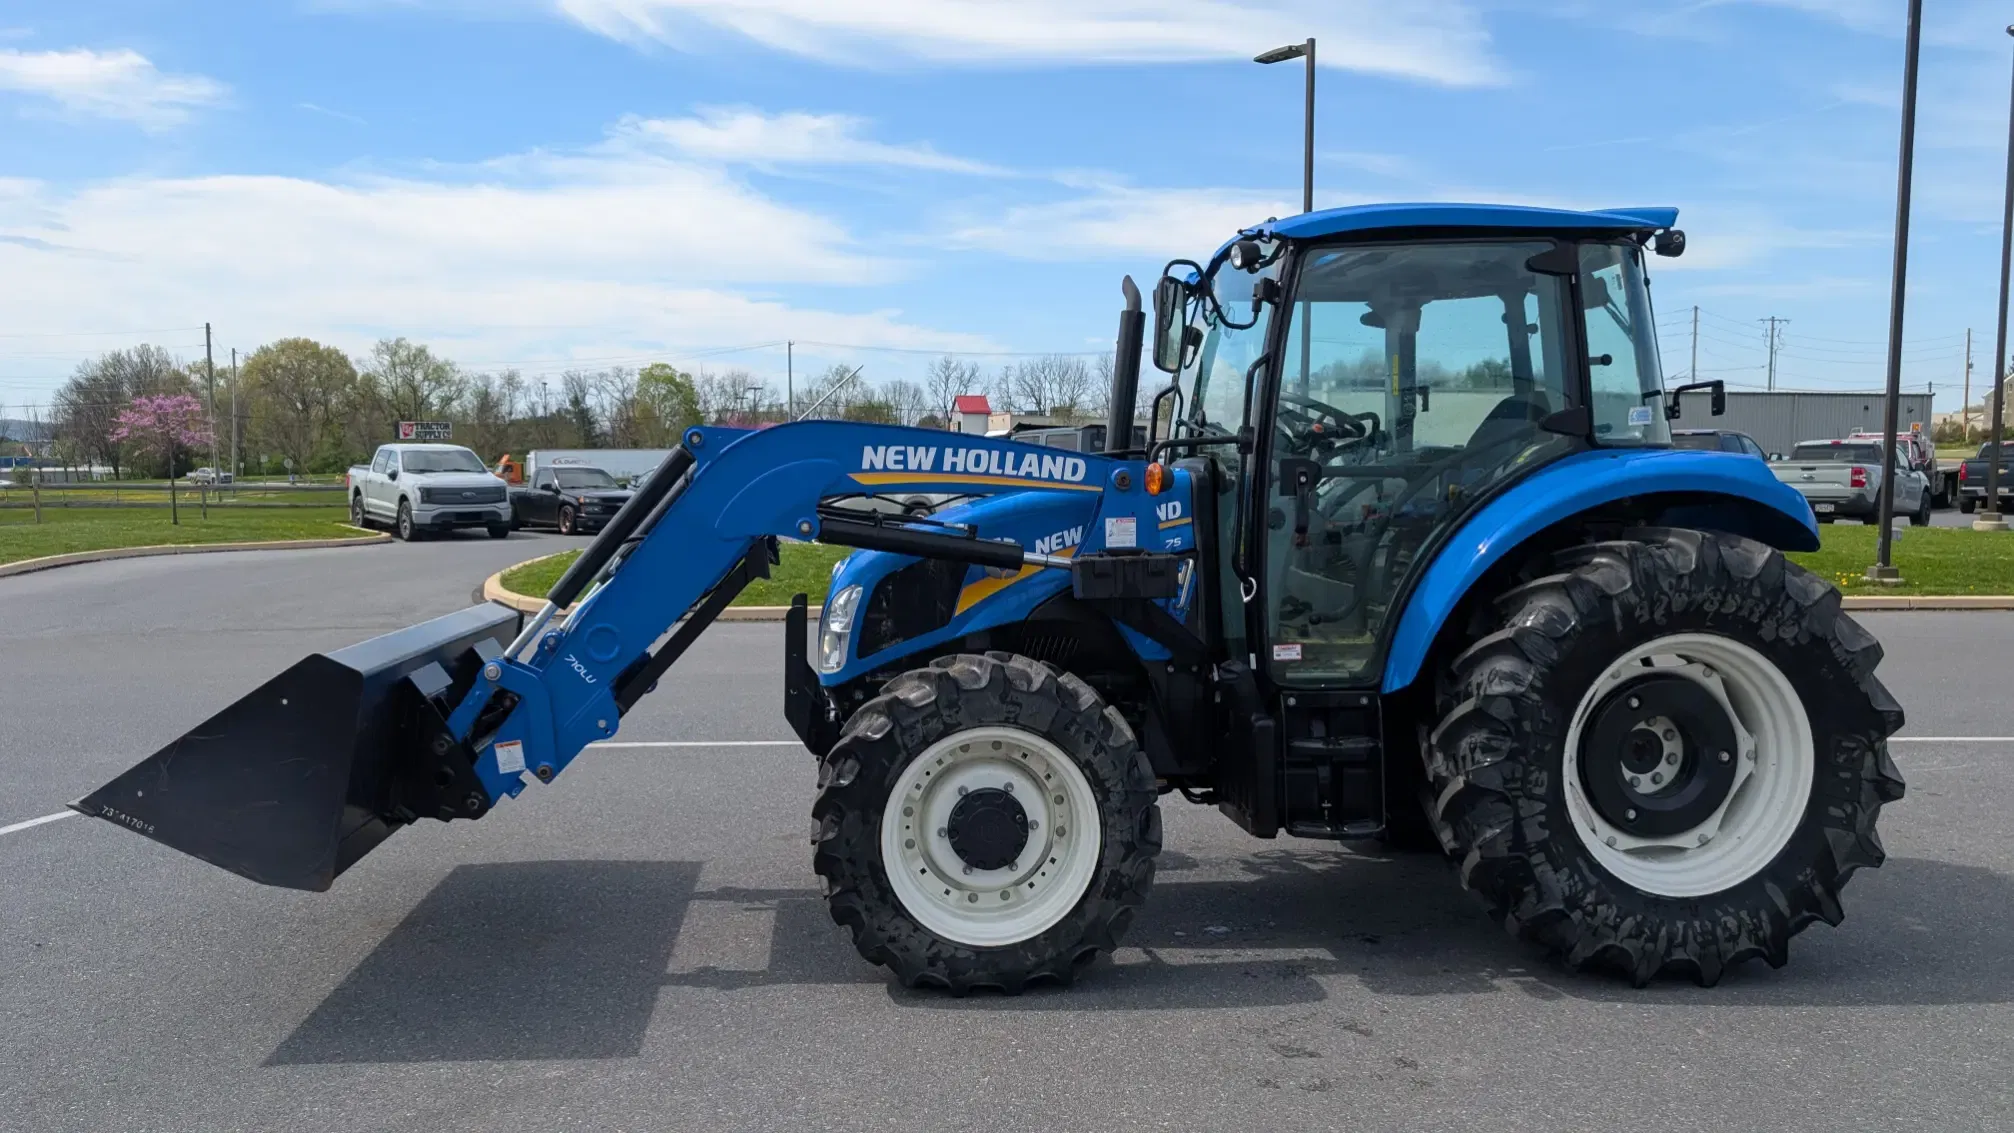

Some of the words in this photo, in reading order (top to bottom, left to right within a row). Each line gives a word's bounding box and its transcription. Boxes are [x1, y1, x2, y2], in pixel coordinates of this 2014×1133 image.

[415, 431, 441, 439] SUPPLY
[861, 445, 937, 470] NEW
[943, 447, 1086, 482] HOLLAND
[1035, 525, 1083, 555] NEW
[1165, 537, 1182, 549] 75
[564, 653, 597, 684] 710LU
